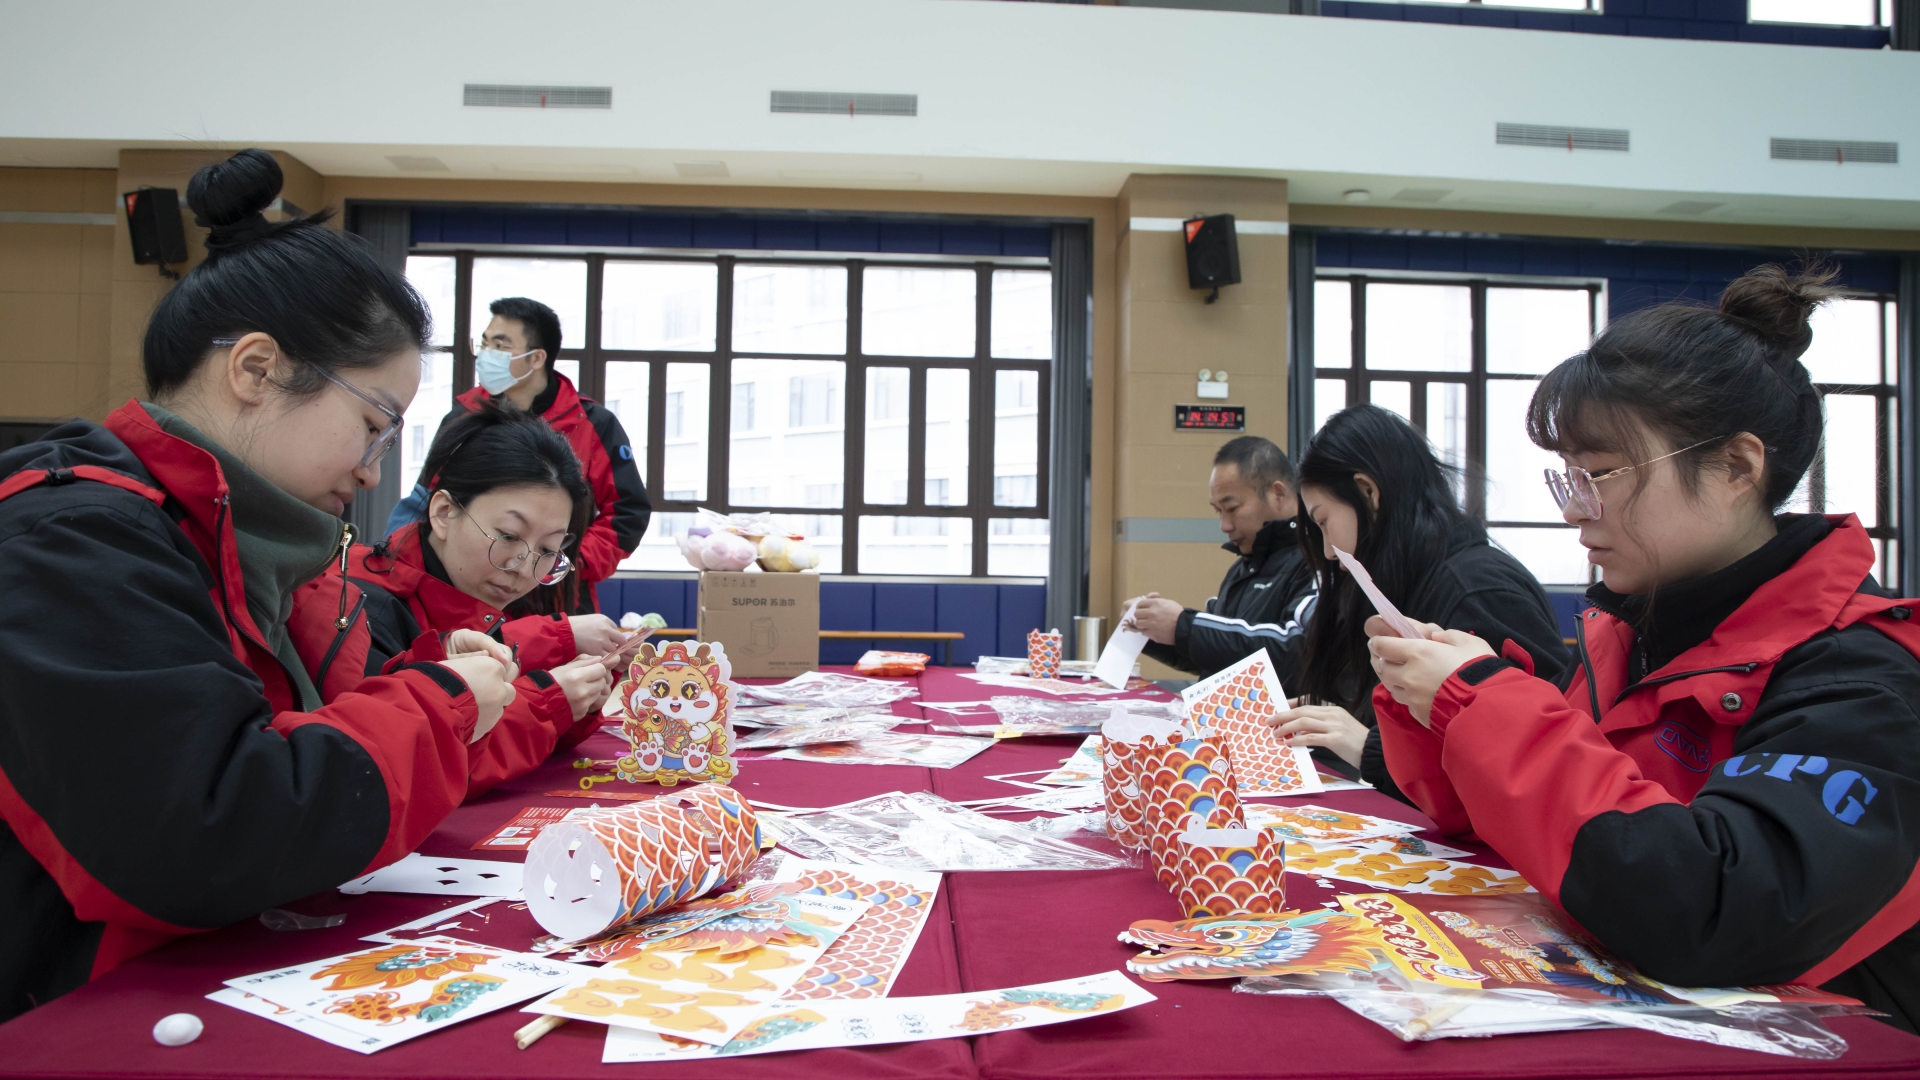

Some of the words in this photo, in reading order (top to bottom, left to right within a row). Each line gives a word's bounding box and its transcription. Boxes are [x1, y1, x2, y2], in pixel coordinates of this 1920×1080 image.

[732, 598, 767, 606] SUPOR
[770, 598, 796, 607] 苏泊尔
[1723, 752, 1879, 826] CPG
